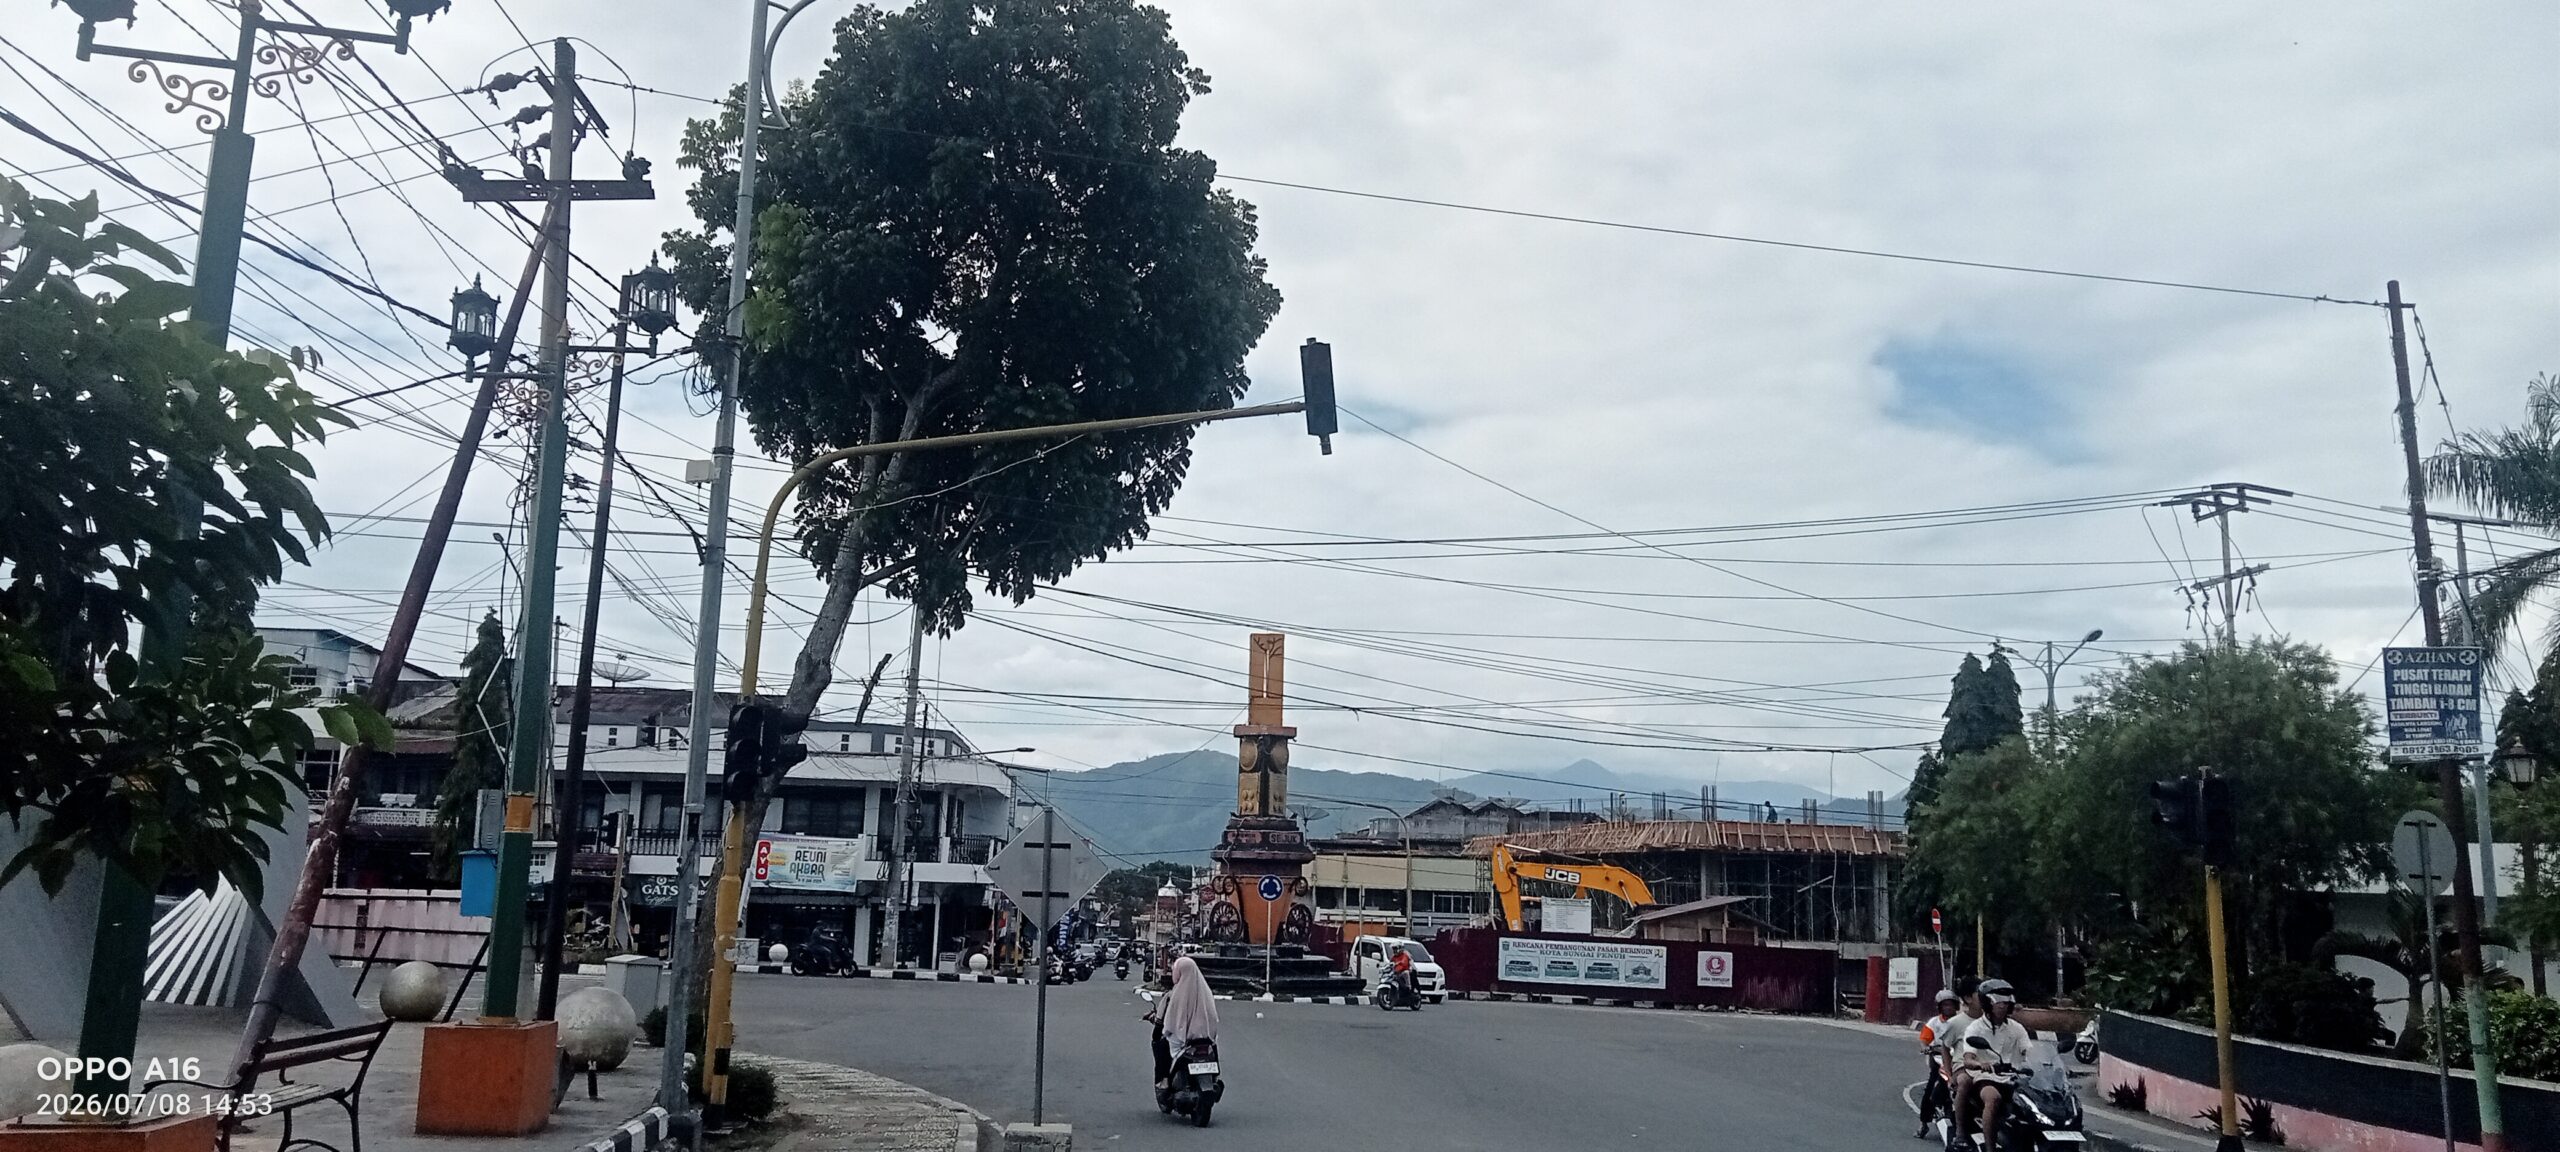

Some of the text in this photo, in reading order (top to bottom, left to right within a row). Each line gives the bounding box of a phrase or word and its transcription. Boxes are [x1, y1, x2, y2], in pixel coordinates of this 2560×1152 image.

[2405, 652, 2456, 663] AZHAN
[2393, 669, 2471, 681] PUSAT TERAPI
[2392, 683, 2472, 695] TINGGI BADAN
[2389, 698, 2437, 710] TAMBAH
[2457, 699, 2476, 710] CM
[757, 846, 768, 875] AYO
[795, 850, 827, 862] REUNI
[789, 863, 825, 880] AKBAR
[1545, 868, 1580, 883] JCB
[642, 884, 679, 895] GATS
[1512, 941, 1544, 949] RENCANA
[1545, 943, 1595, 952] PEMBANGUNAN
[1620, 947, 1652, 955] BERINGIN
[1597, 952, 1626, 960] PENUH
